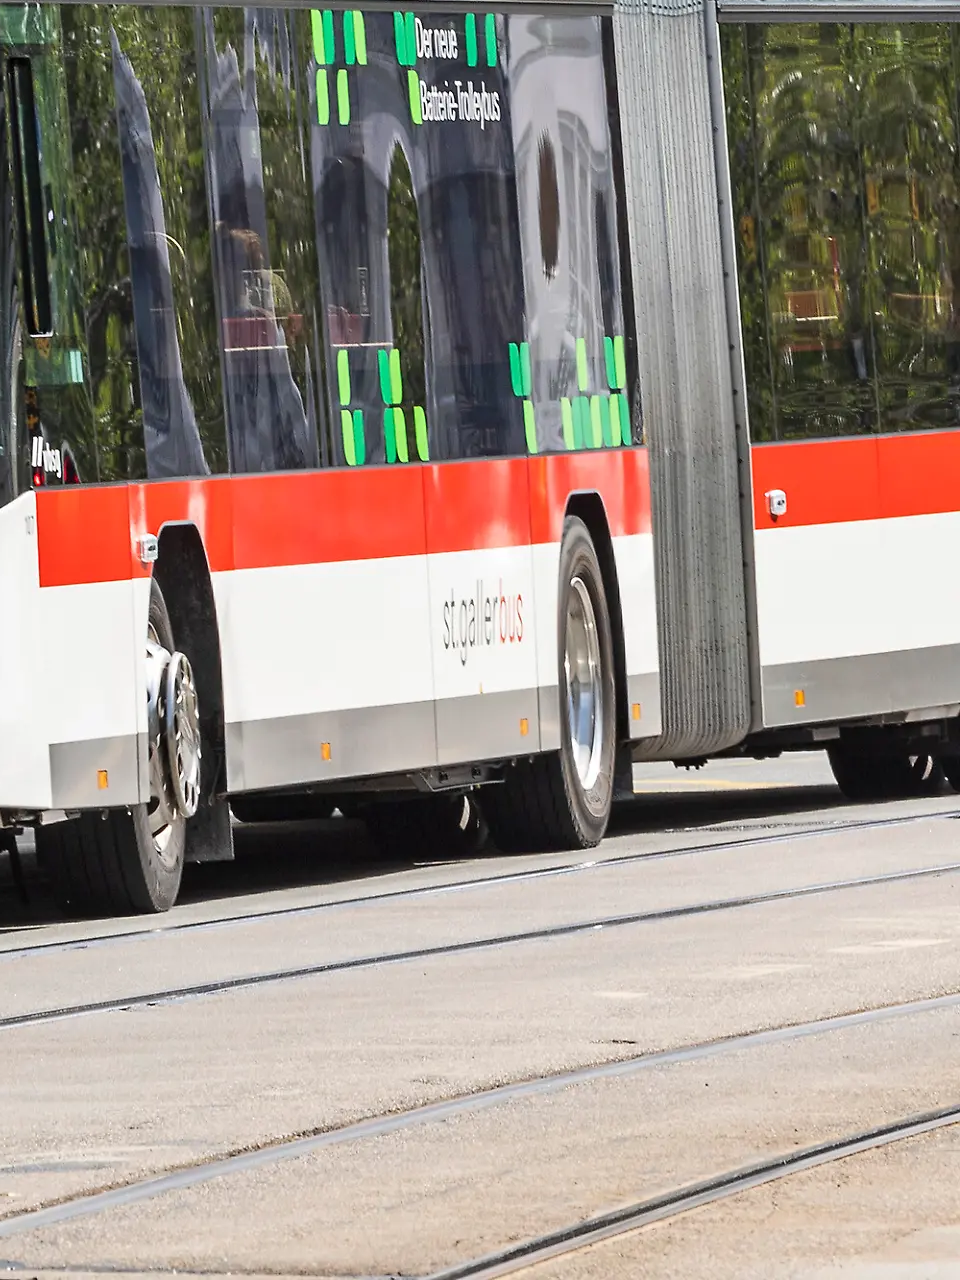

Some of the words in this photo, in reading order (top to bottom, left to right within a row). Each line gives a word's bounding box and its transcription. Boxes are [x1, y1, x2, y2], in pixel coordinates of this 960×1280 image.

[415, 17, 433, 59] Der
[434, 28, 458, 59] neue
[443, 578, 524, 666] st.gallerbus
